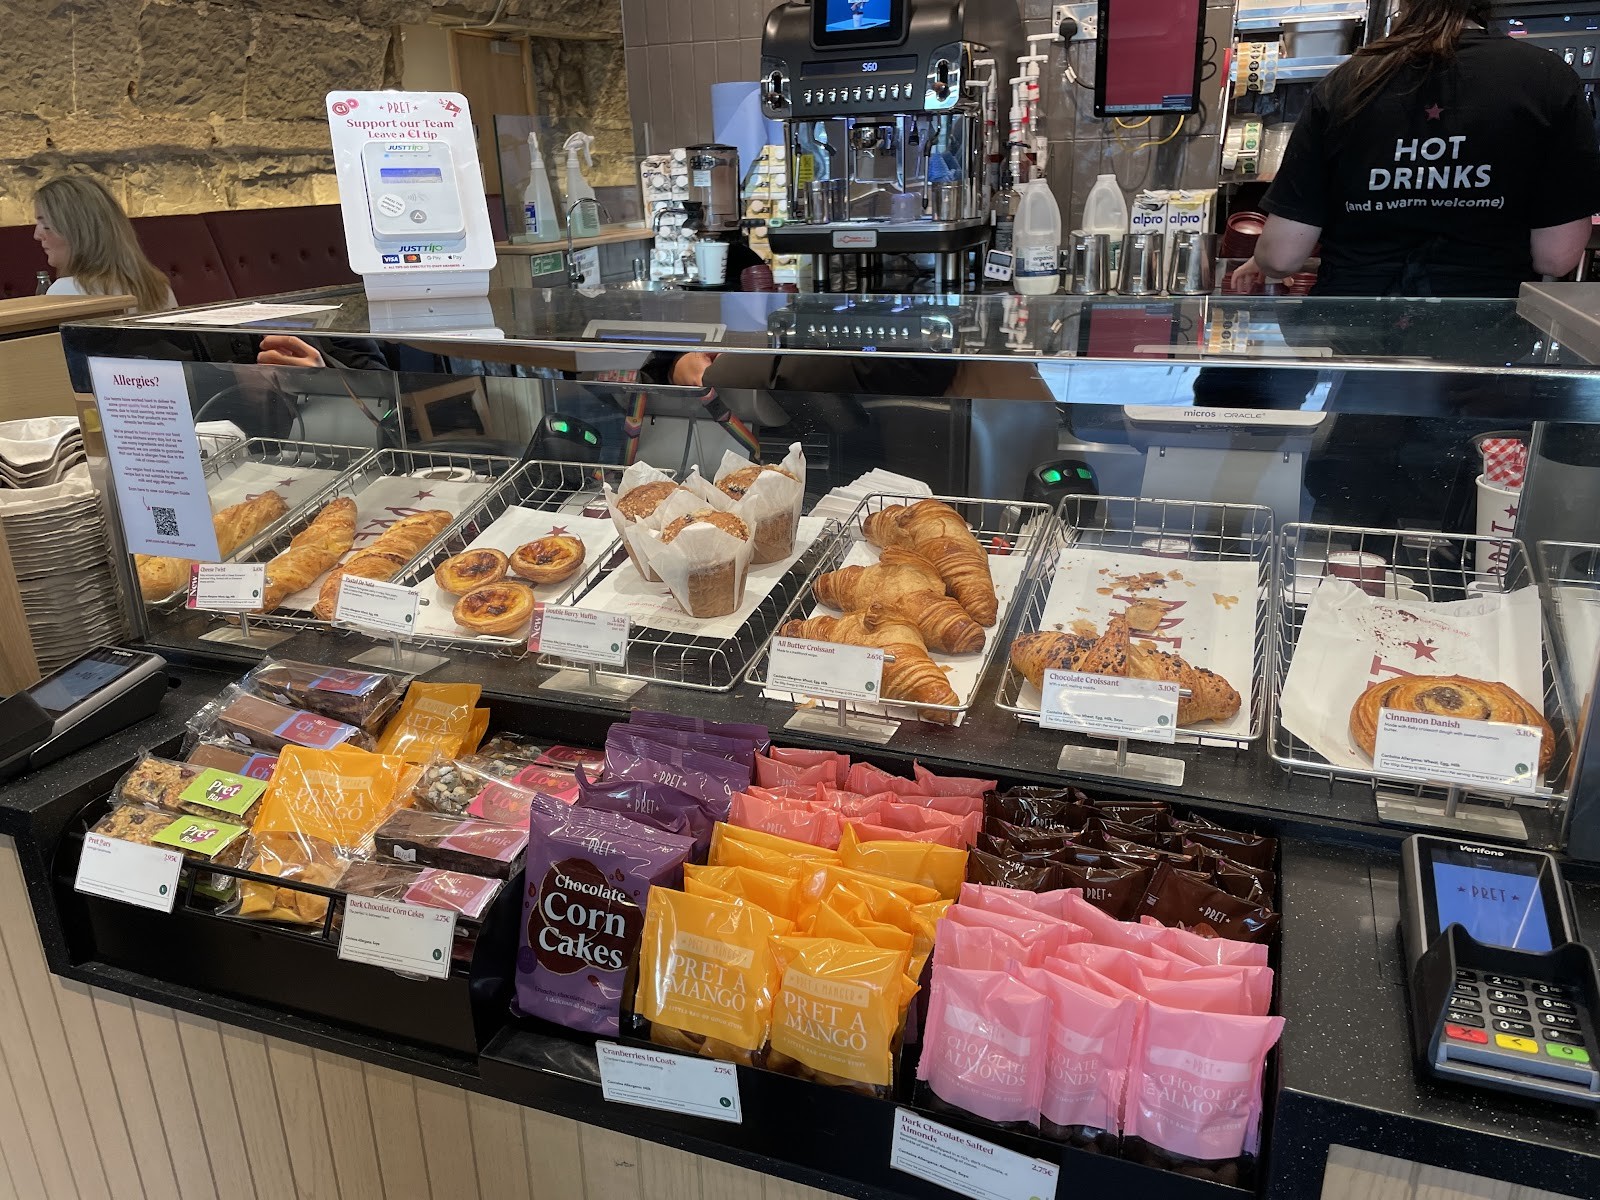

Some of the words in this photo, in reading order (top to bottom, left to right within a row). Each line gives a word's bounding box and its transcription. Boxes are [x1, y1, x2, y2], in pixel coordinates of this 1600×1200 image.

[862, 62, 877, 71] S60
[388, 103, 410, 113] PRET
[347, 120, 397, 129] Support
[423, 120, 454, 128] Team
[408, 130, 421, 138] €1
[1394, 136, 1466, 161] HOT
[1369, 165, 1491, 190] DRINKS
[1346, 199, 1372, 212] (and
[1375, 201, 1382, 211] a
[1387, 197, 1426, 209] warm
[1431, 196, 1504, 209] welcome)
[1133, 213, 1162, 226] alpro
[1170, 212, 1199, 225] alpro
[113, 375, 159, 389] Allergies?
[190, 576, 198, 596] New
[565, 610, 578, 618] Berry
[531, 617, 541, 639] New
[787, 642, 806, 650] Butter
[807, 645, 835, 654] Croissant
[1049, 673, 1083, 683] Chocolate
[1086, 677, 1119, 686] Croissant
[1385, 712, 1428, 725] Cinnamon
[1431, 717, 1460, 728] Danish
[397, 727, 442, 744] ANGO
[659, 770, 683, 789] PRET
[208, 780, 240, 797] Pret
[208, 793, 223, 802] Bar
[351, 793, 364, 807] A
[634, 798, 656, 814] PRET
[89, 836, 99, 844] Pret
[181, 836, 196, 844] Bar
[183, 826, 216, 839] Pret
[588, 838, 612, 856] PRET
[1460, 846, 1504, 856] Verifone
[555, 874, 626, 903] Chocolate
[1086, 888, 1107, 901] PRET
[1472, 885, 1505, 902] PRET
[350, 899, 363, 908] Dark
[364, 902, 392, 913] Chocolate
[393, 907, 406, 915] Corn
[408, 910, 424, 919] Cakes
[544, 892, 626, 938] Corn
[1204, 907, 1227, 923] PRET
[538, 926, 623, 969] Cakes
[673, 955, 728, 986] PRET
[734, 973, 746, 993] A
[668, 976, 745, 1012] MANGO
[1543, 999, 1552, 1007] 6
[784, 991, 842, 1026] PRET
[850, 1012, 866, 1033] A
[1546, 1014, 1555, 1022] 9
[785, 1012, 867, 1051] MANGO
[1500, 1021, 1509, 1029] 0
[603, 1047, 646, 1061] Cranberries
[656, 1057, 676, 1066] Coats
[944, 1049, 1025, 1086] ALMONDS
[1192, 1059, 1215, 1074] PRET
[901, 1124, 938, 1143] Almonds
[902, 1115, 921, 1129] Dark
[923, 1123, 965, 1145] Chocolate
[966, 1139, 994, 1155] Salted
[1031, 1163, 1054, 1177] 2.75€
